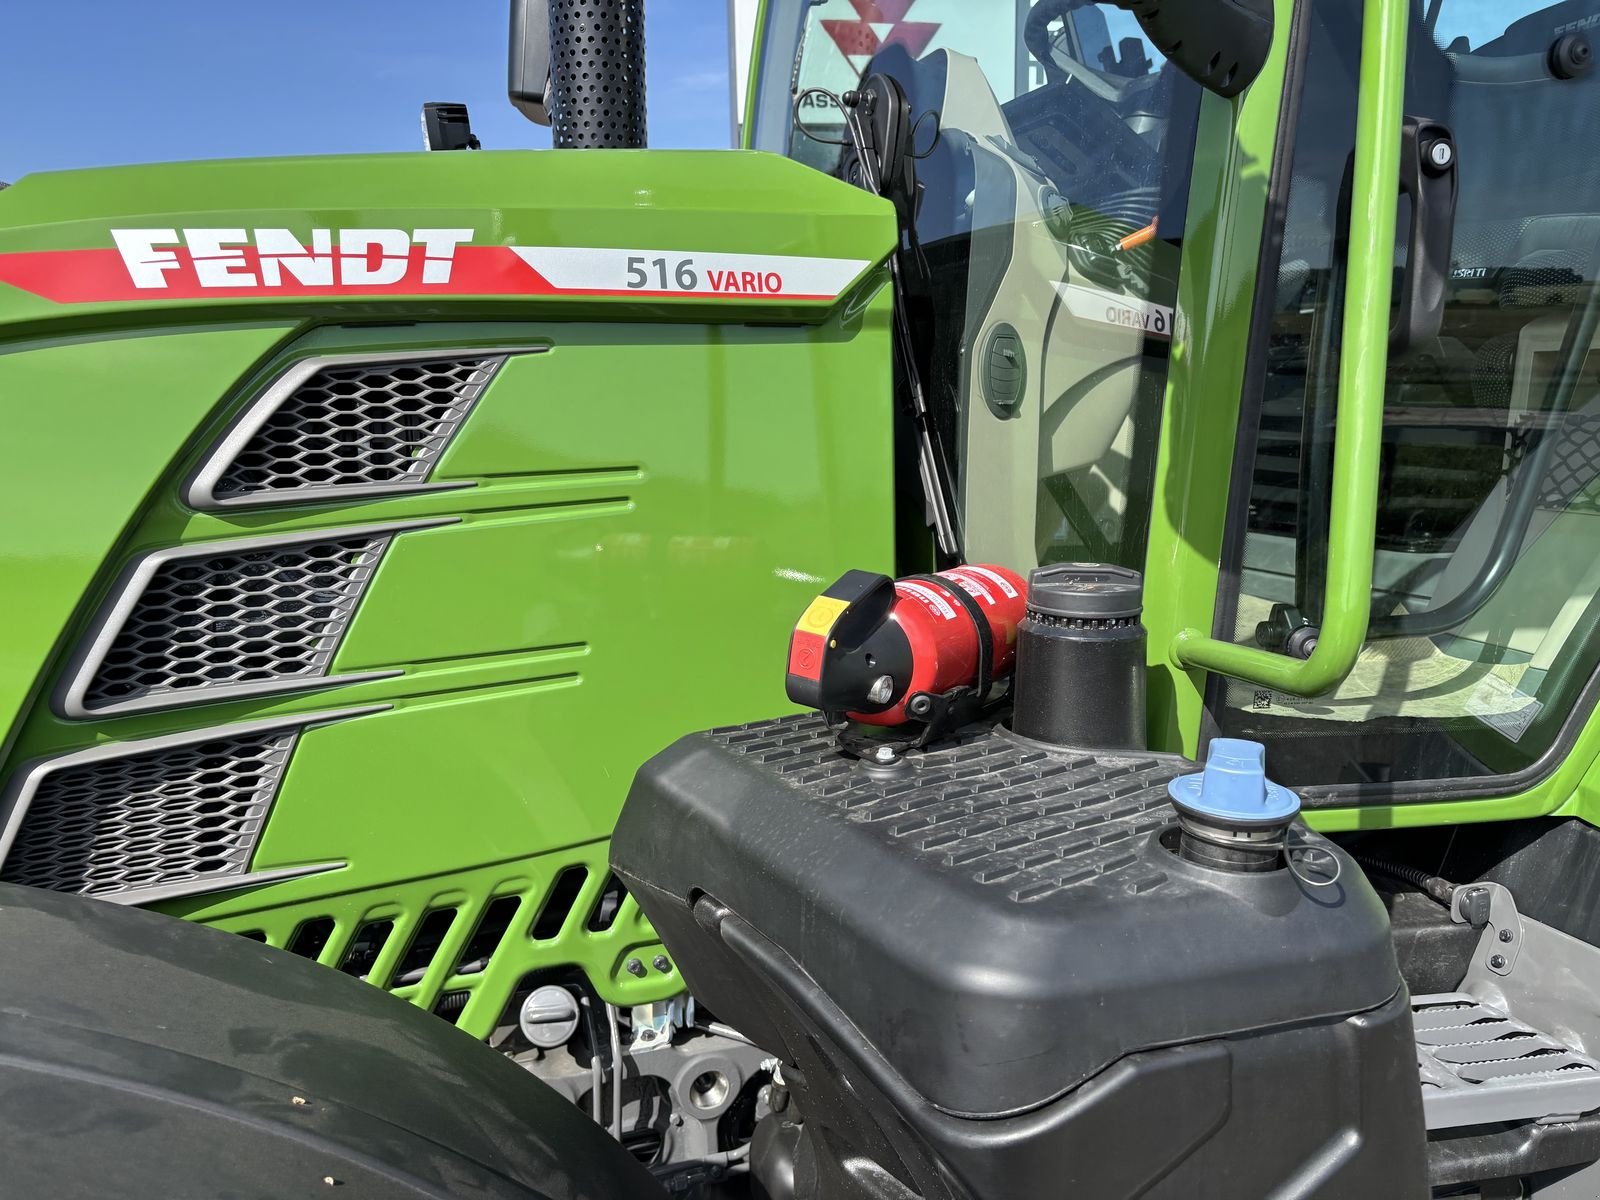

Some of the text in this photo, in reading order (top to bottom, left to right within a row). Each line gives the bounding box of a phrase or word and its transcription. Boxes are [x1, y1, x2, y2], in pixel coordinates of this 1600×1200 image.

[110, 228, 474, 288] FENDT
[626, 256, 783, 293] 516 VARIO
